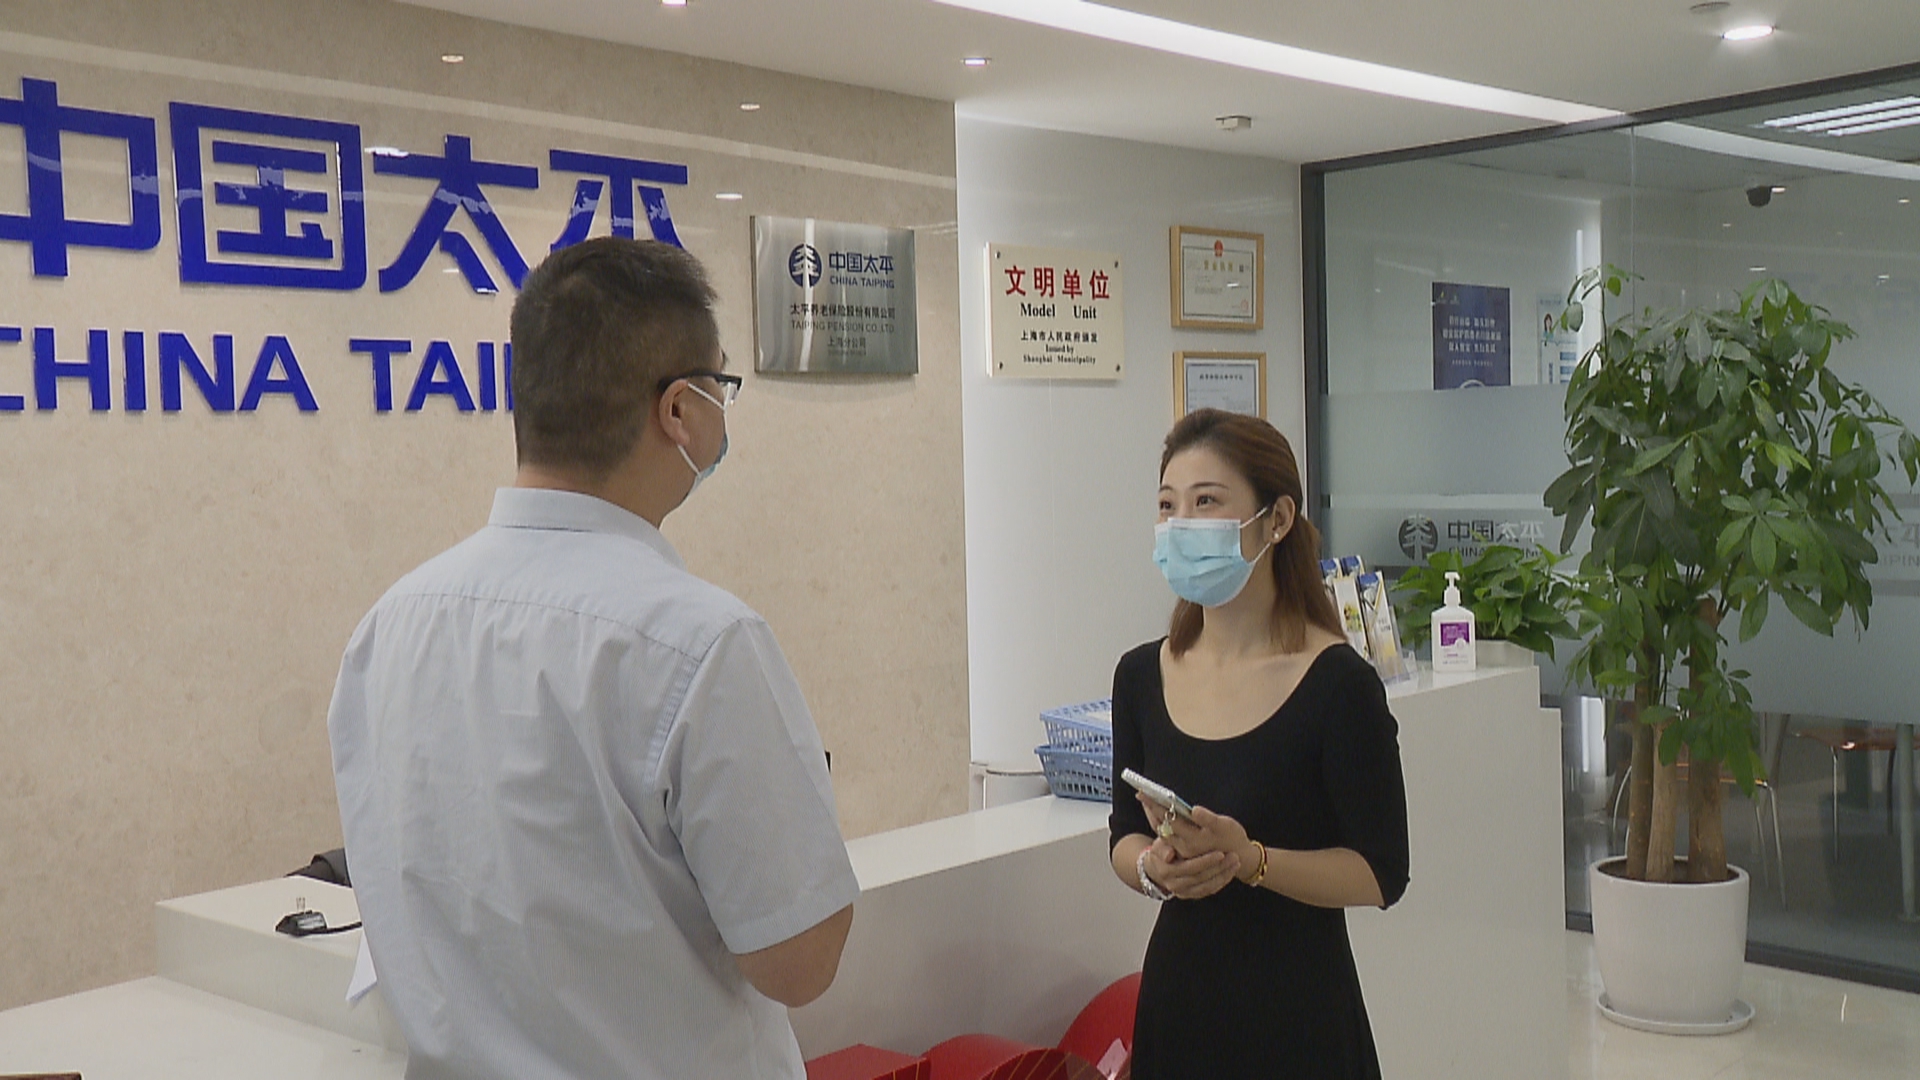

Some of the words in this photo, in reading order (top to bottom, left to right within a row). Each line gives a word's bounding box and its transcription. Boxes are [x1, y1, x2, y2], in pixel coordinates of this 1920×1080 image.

[0, 77, 688, 292] 中国太平
[829, 251, 894, 275] 中国太平
[830, 276, 857, 286] CHINA
[861, 278, 894, 288] TAIPING
[1004, 264, 1110, 300] 文明单位
[1020, 302, 1056, 318] Model
[1073, 305, 1097, 319] Unit
[792, 320, 825, 330] TAIPING
[828, 321, 864, 332] PENSION
[1021, 329, 1098, 343] 上海市人民政府颁发
[1045, 344, 1066, 353] Issued
[1066, 344, 1074, 354] by
[1023, 355, 1053, 365] Shanghai
[1057, 356, 1096, 365] Municipality
[349, 338, 513, 412] TAI
[1448, 520, 1544, 543] 中国太平
